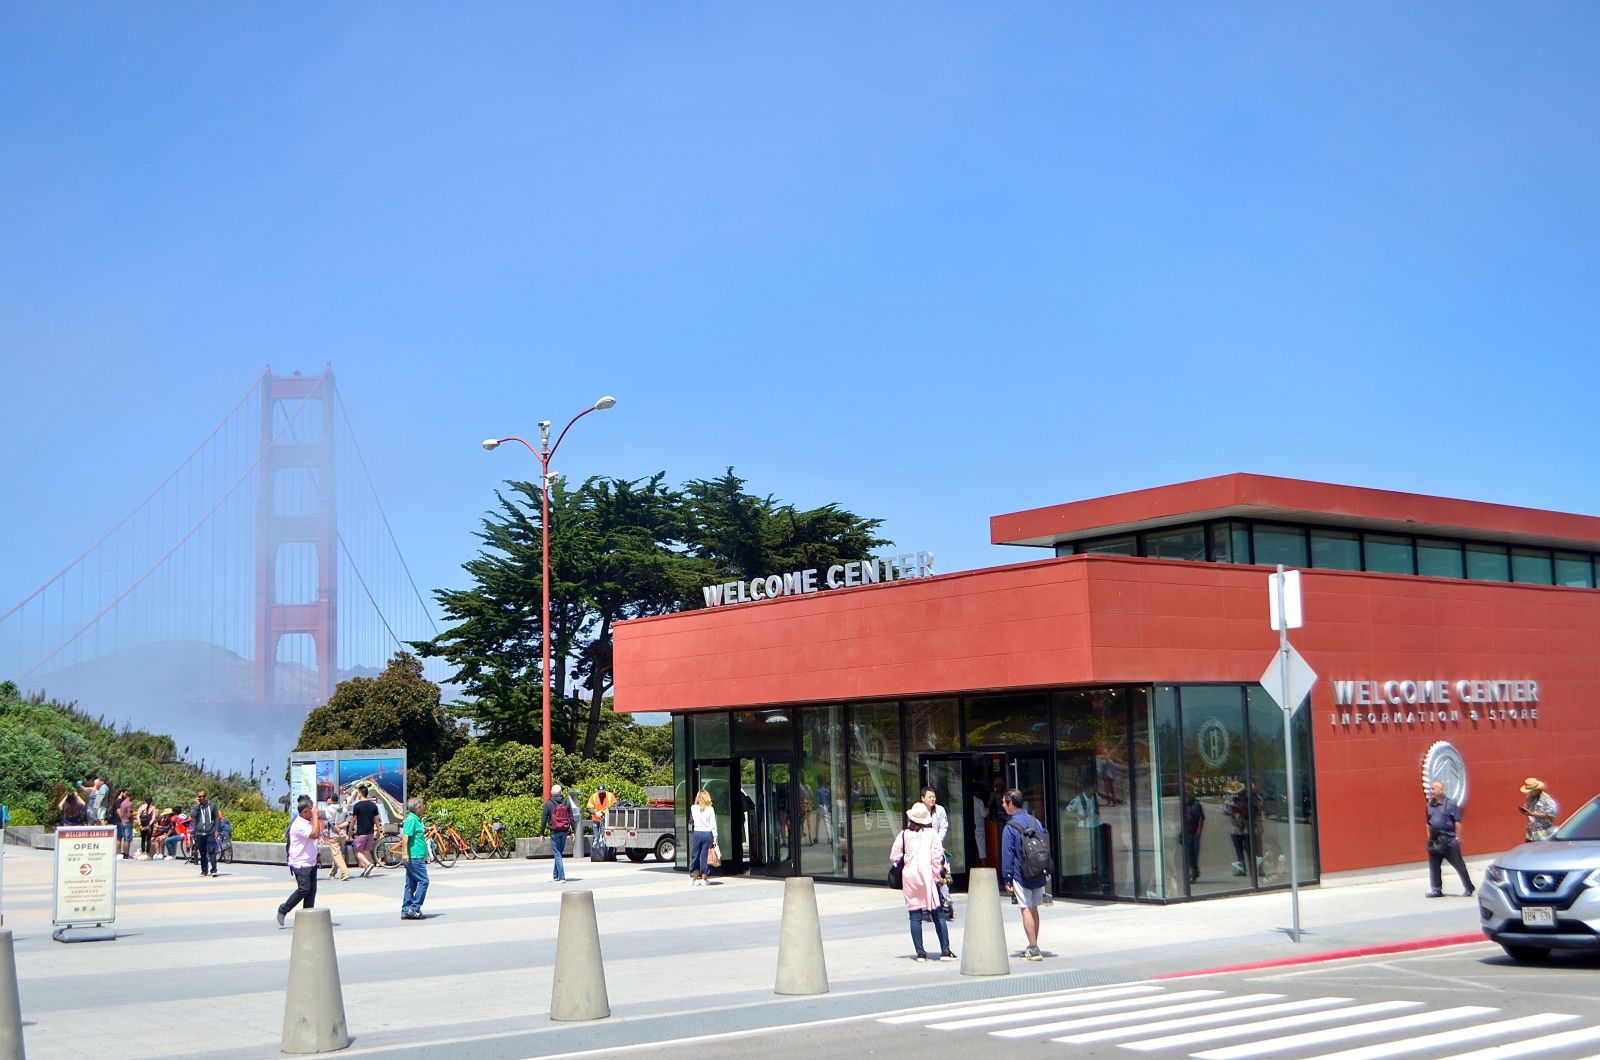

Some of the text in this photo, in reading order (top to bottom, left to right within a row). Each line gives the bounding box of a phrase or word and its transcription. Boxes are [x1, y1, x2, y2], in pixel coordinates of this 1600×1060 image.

[702, 550, 935, 607] WELCOME CENTER
[1332, 679, 1539, 705] WELCOME CENTER
[1330, 709, 1538, 726] INFORMATION & STORE
